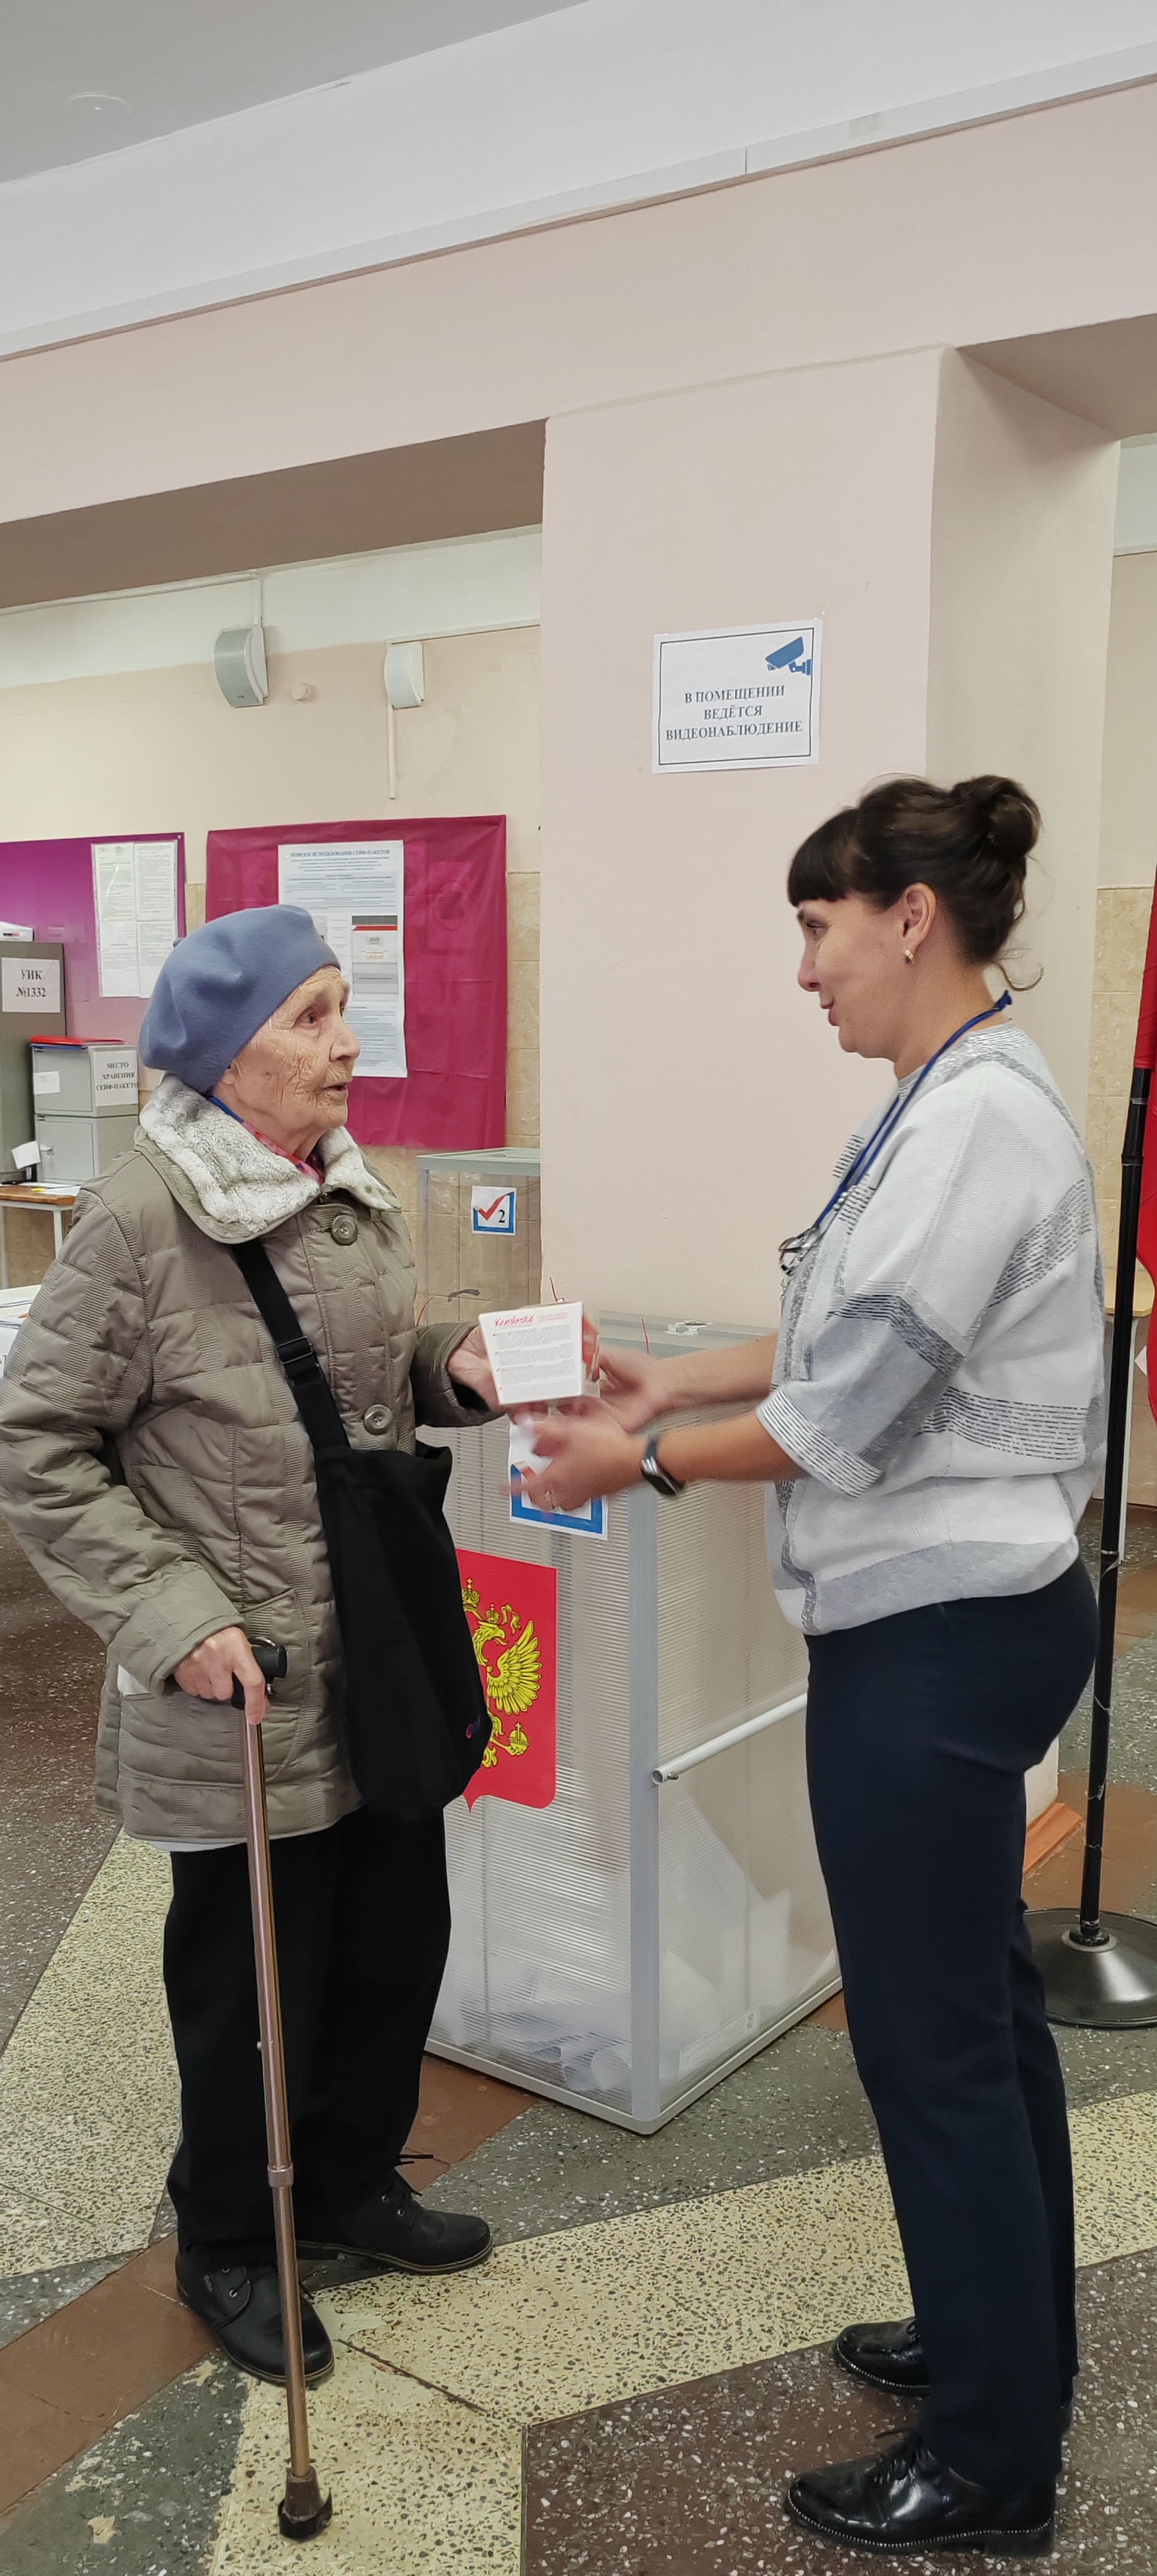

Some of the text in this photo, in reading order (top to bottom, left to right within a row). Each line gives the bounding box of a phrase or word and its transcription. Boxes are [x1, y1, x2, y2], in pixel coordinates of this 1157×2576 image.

[684, 685, 785, 704] В ПОМЕЩЕНИИ
[704, 705, 763, 720] ВЕДЁТСЯ
[666, 721, 803, 740] ВИДЕОНАБЛЮДЕНИЕ
[21, 969, 42, 980] УИК
[16, 987, 47, 997] №1332
[498, 1209, 506, 1223] 2
